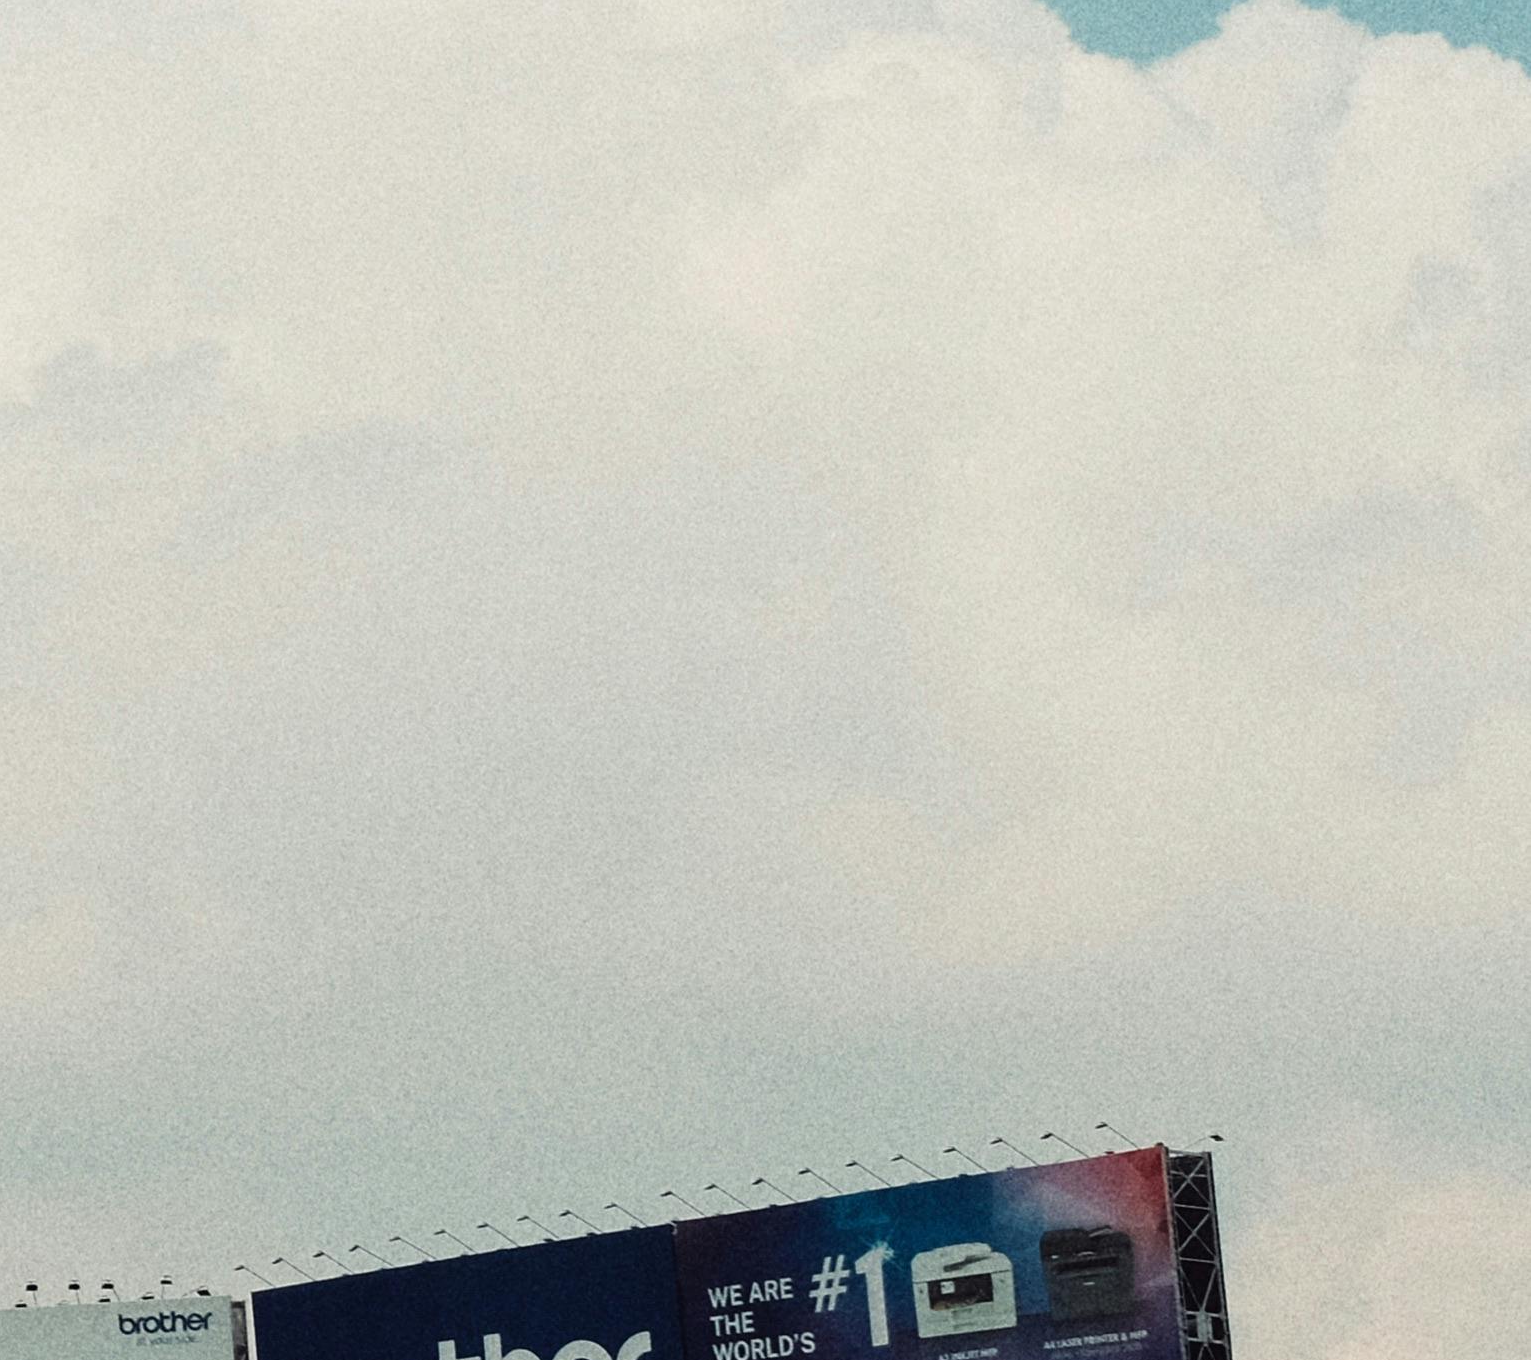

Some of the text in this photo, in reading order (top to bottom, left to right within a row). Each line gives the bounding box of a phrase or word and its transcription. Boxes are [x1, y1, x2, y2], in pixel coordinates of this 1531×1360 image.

[707, 1277, 794, 1308] WE ARE
[809, 1243, 891, 1347] #1
[118, 1311, 212, 1335] brother
[710, 1311, 755, 1337] THE
